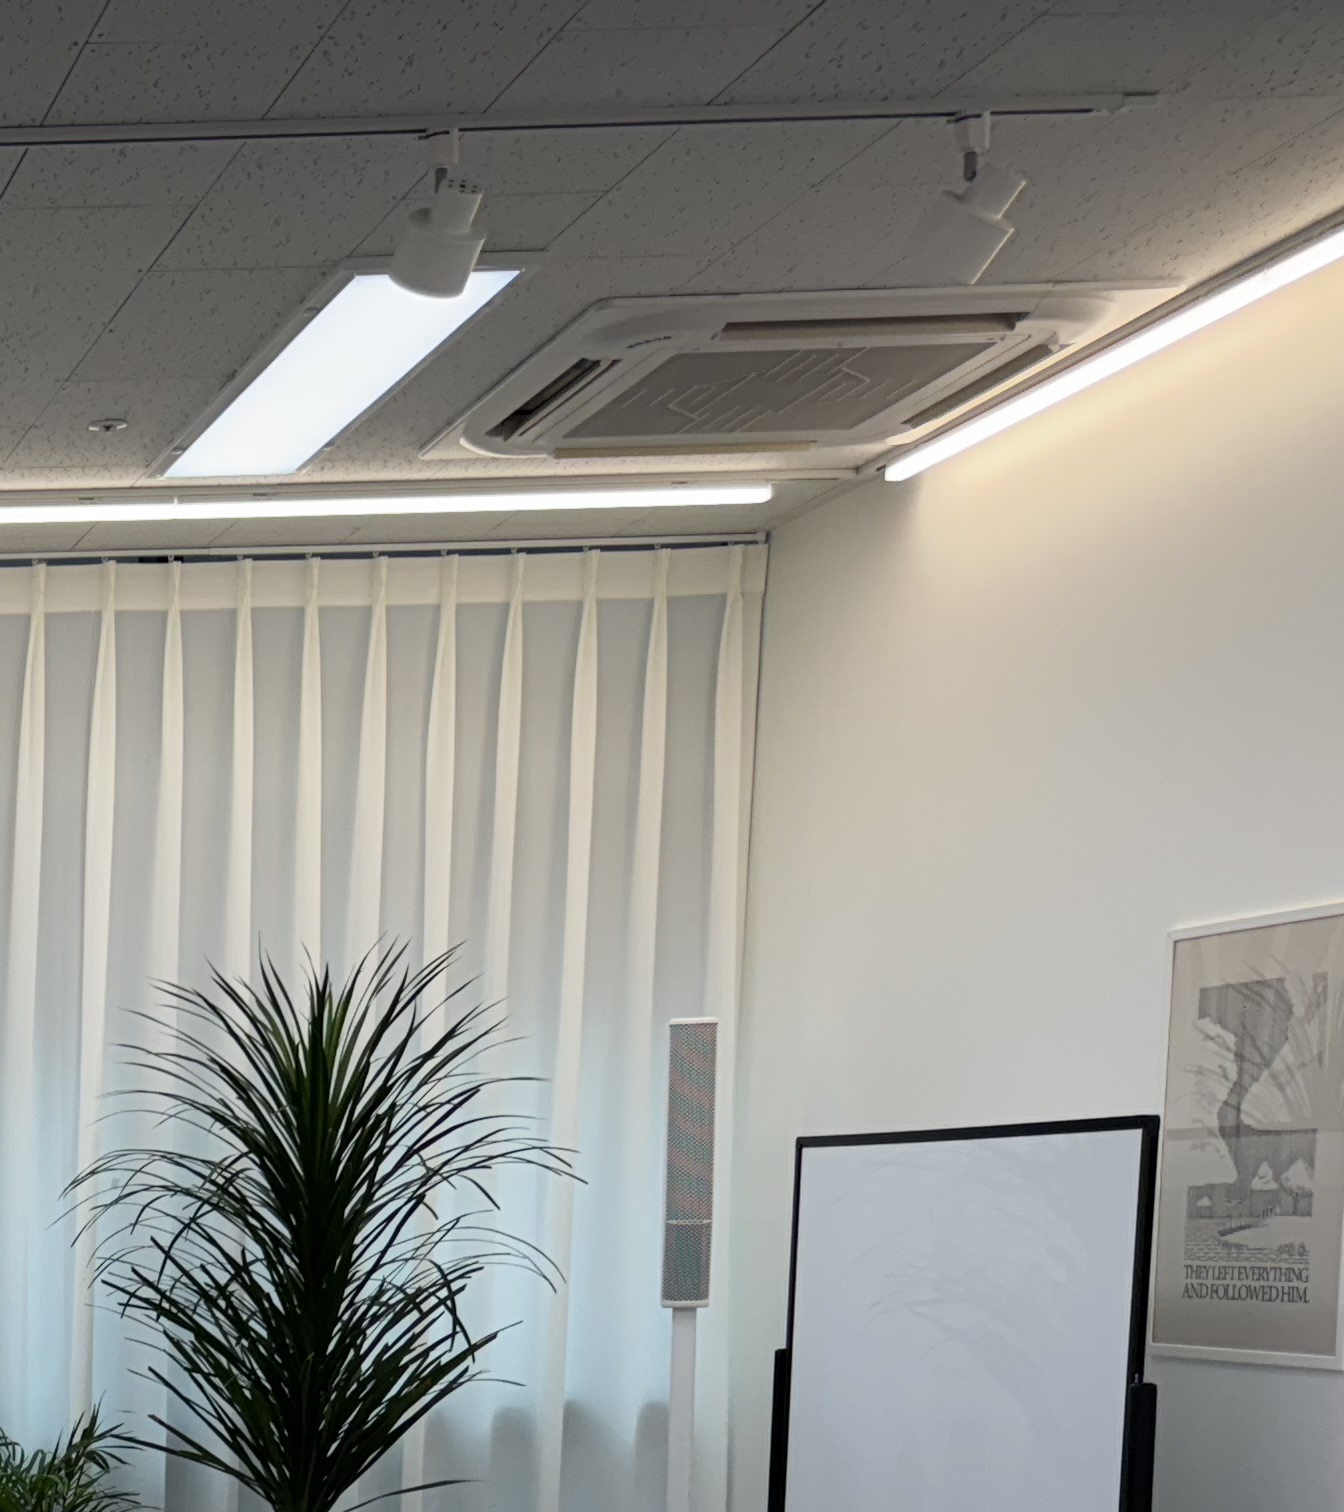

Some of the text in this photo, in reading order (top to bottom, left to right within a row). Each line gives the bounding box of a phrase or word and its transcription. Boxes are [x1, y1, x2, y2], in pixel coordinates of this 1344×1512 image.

[1183, 1264, 1310, 1284] THEY LEFT EVERYTHING
[1181, 1282, 1209, 1299] AND
[1210, 1283, 1280, 1302] FOLLOWED
